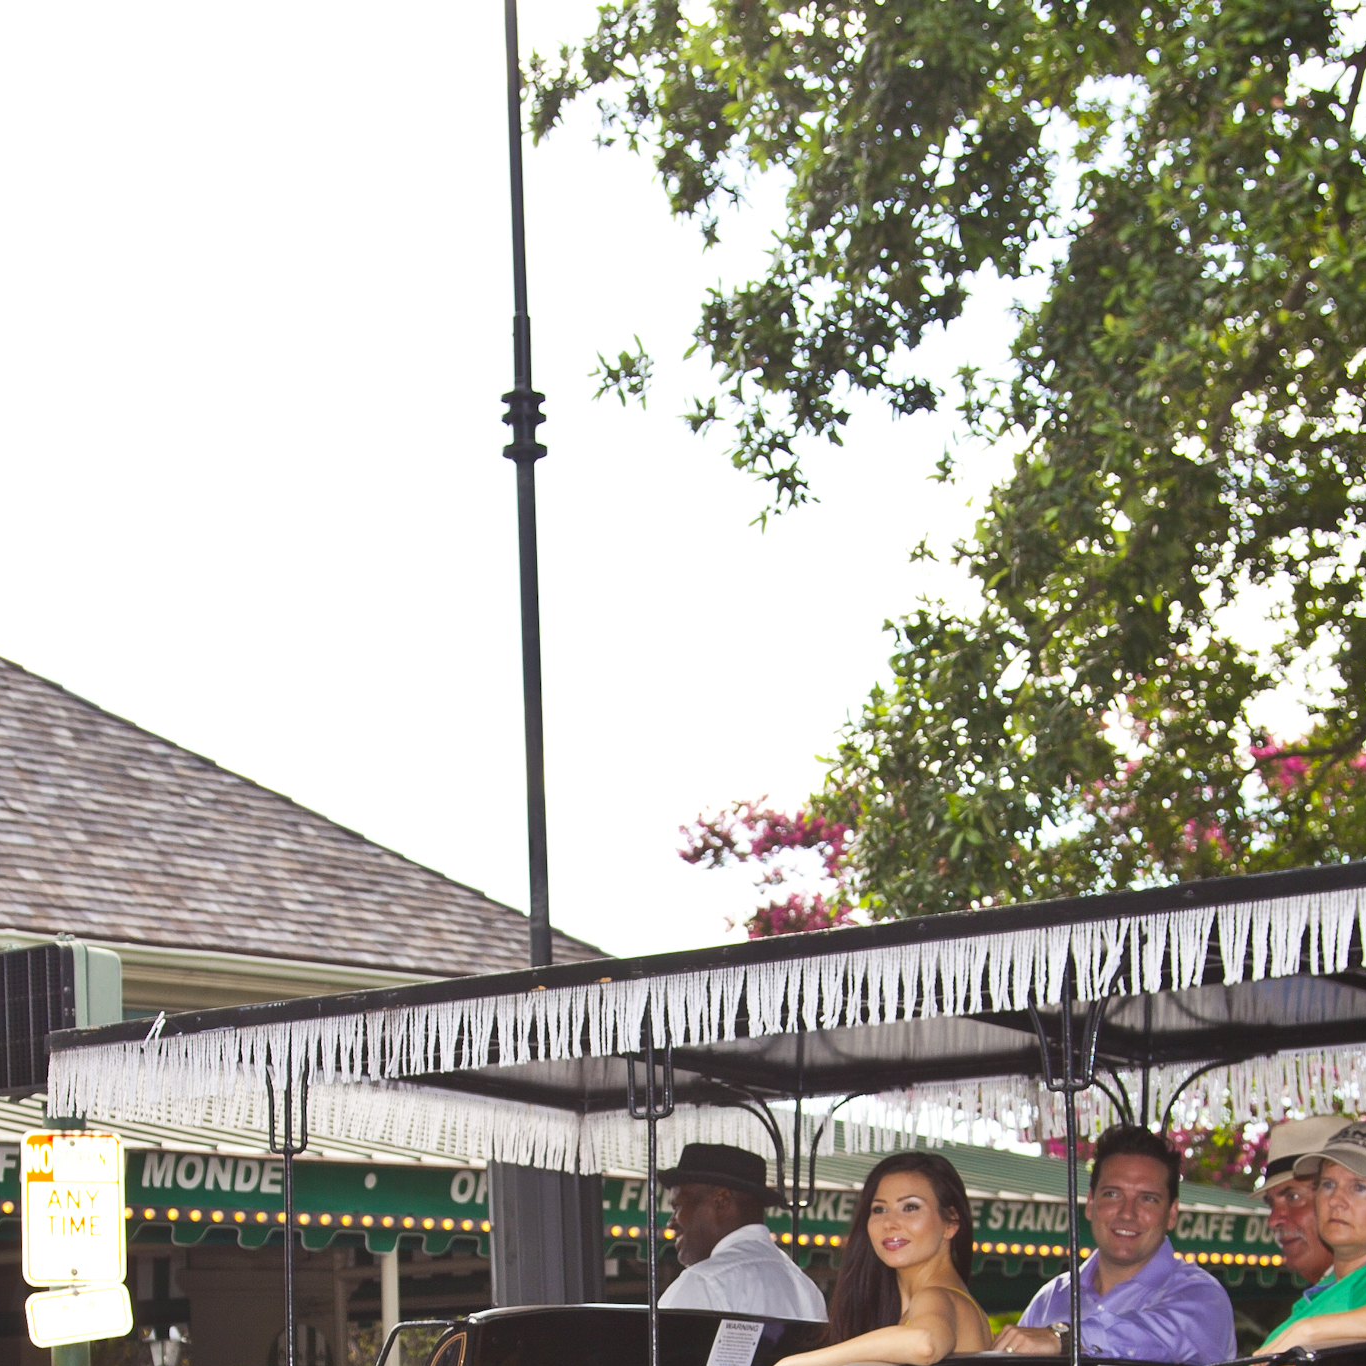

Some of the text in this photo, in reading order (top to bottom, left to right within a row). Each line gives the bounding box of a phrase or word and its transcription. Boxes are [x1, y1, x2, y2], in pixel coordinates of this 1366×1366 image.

[27, 1143, 114, 1174] NO STOPPING
[47, 1189, 99, 1209] ANY
[141, 1152, 287, 1195] MONDE
[987, 1201, 1069, 1233] STAND
[1176, 1213, 1234, 1242] CAFE
[47, 1215, 101, 1236] TIME
[726, 1322, 759, 1332] WARNING
